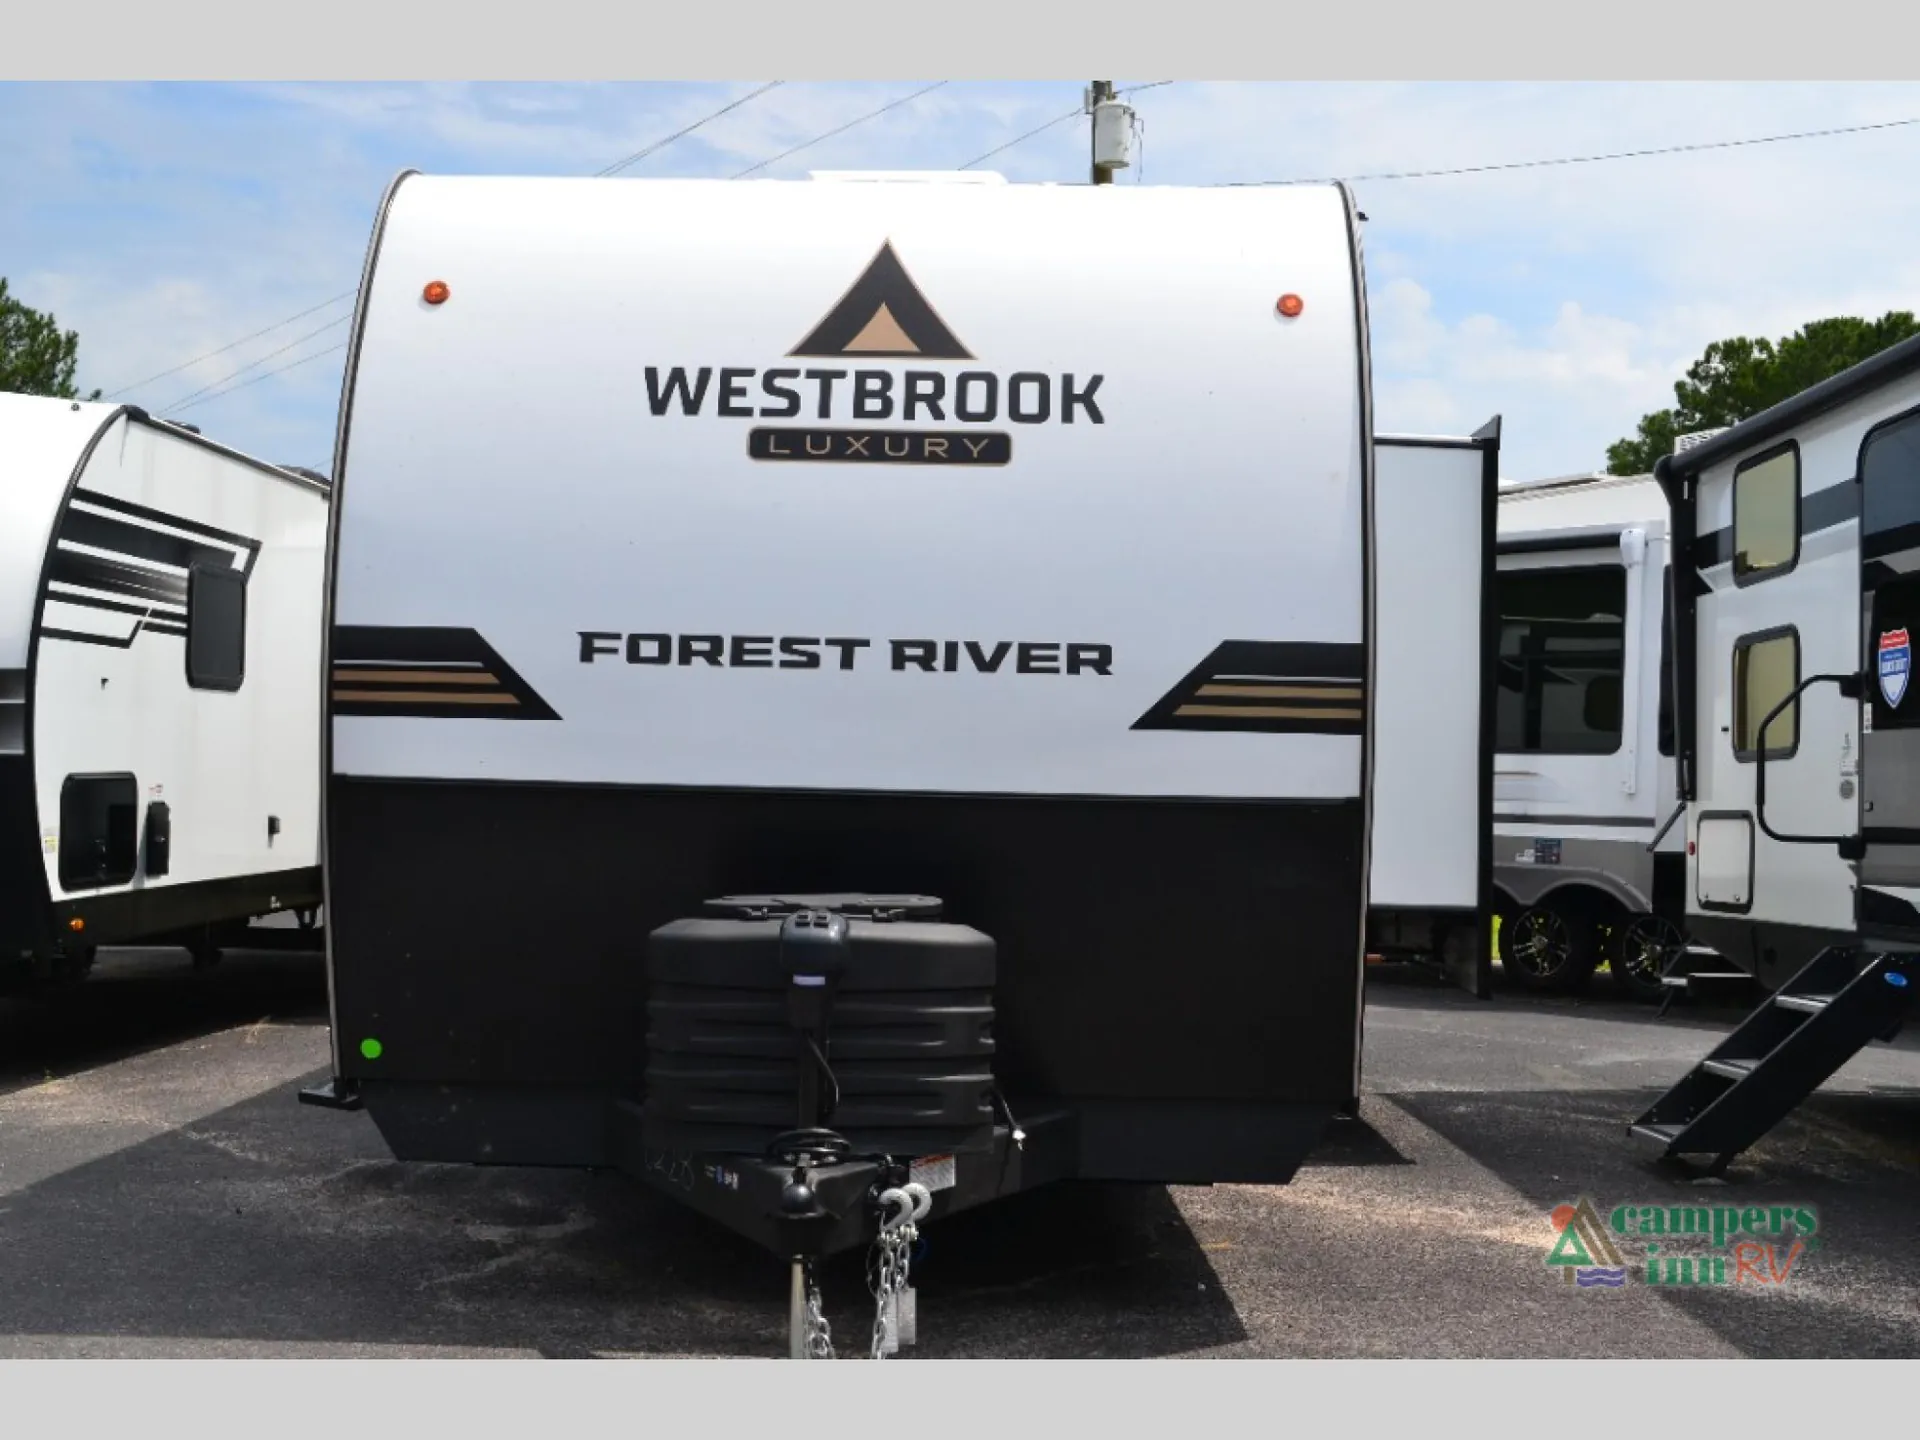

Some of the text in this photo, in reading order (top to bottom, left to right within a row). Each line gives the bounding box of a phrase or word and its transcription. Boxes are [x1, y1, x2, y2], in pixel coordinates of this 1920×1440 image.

[645, 366, 1104, 424] WESTBROOK
[768, 434, 989, 458] LUXURY
[577, 631, 1113, 675] FOREST RIVER
